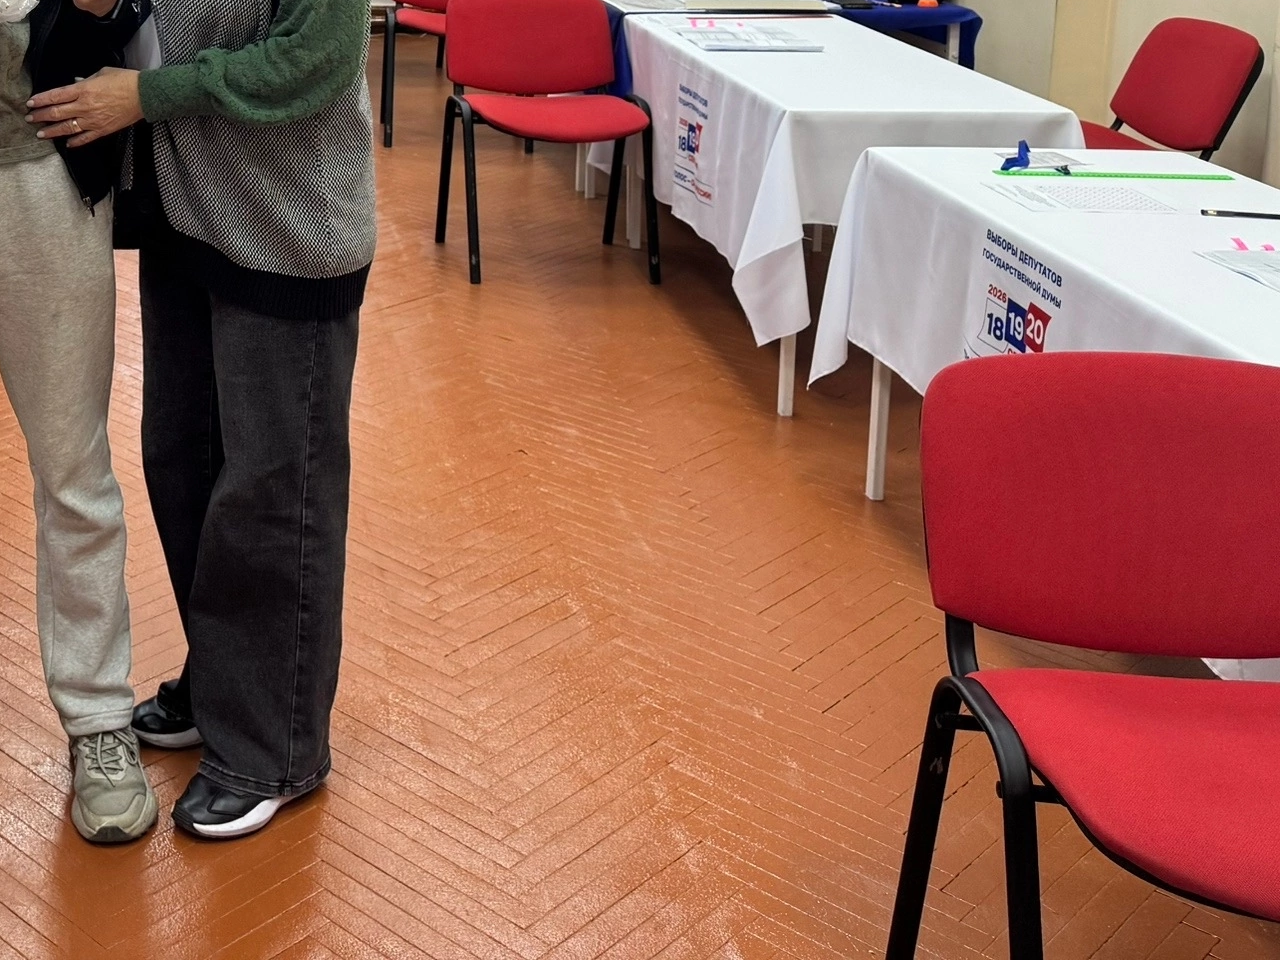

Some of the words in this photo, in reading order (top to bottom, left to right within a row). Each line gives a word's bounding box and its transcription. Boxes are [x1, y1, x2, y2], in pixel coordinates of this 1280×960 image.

[982, 248, 1041, 294] ГОСУДАРСТВЕННОЙ
[1041, 288, 1062, 309] ДУМЫ
[986, 229, 1018, 257] ВЫБОРЫ
[1018, 251, 1062, 287] ДЕПУТАТОВ
[987, 284, 1007, 303] 2026
[987, 312, 1004, 341] 18
[1008, 312, 1024, 341] 19
[1026, 313, 1044, 345] 20
